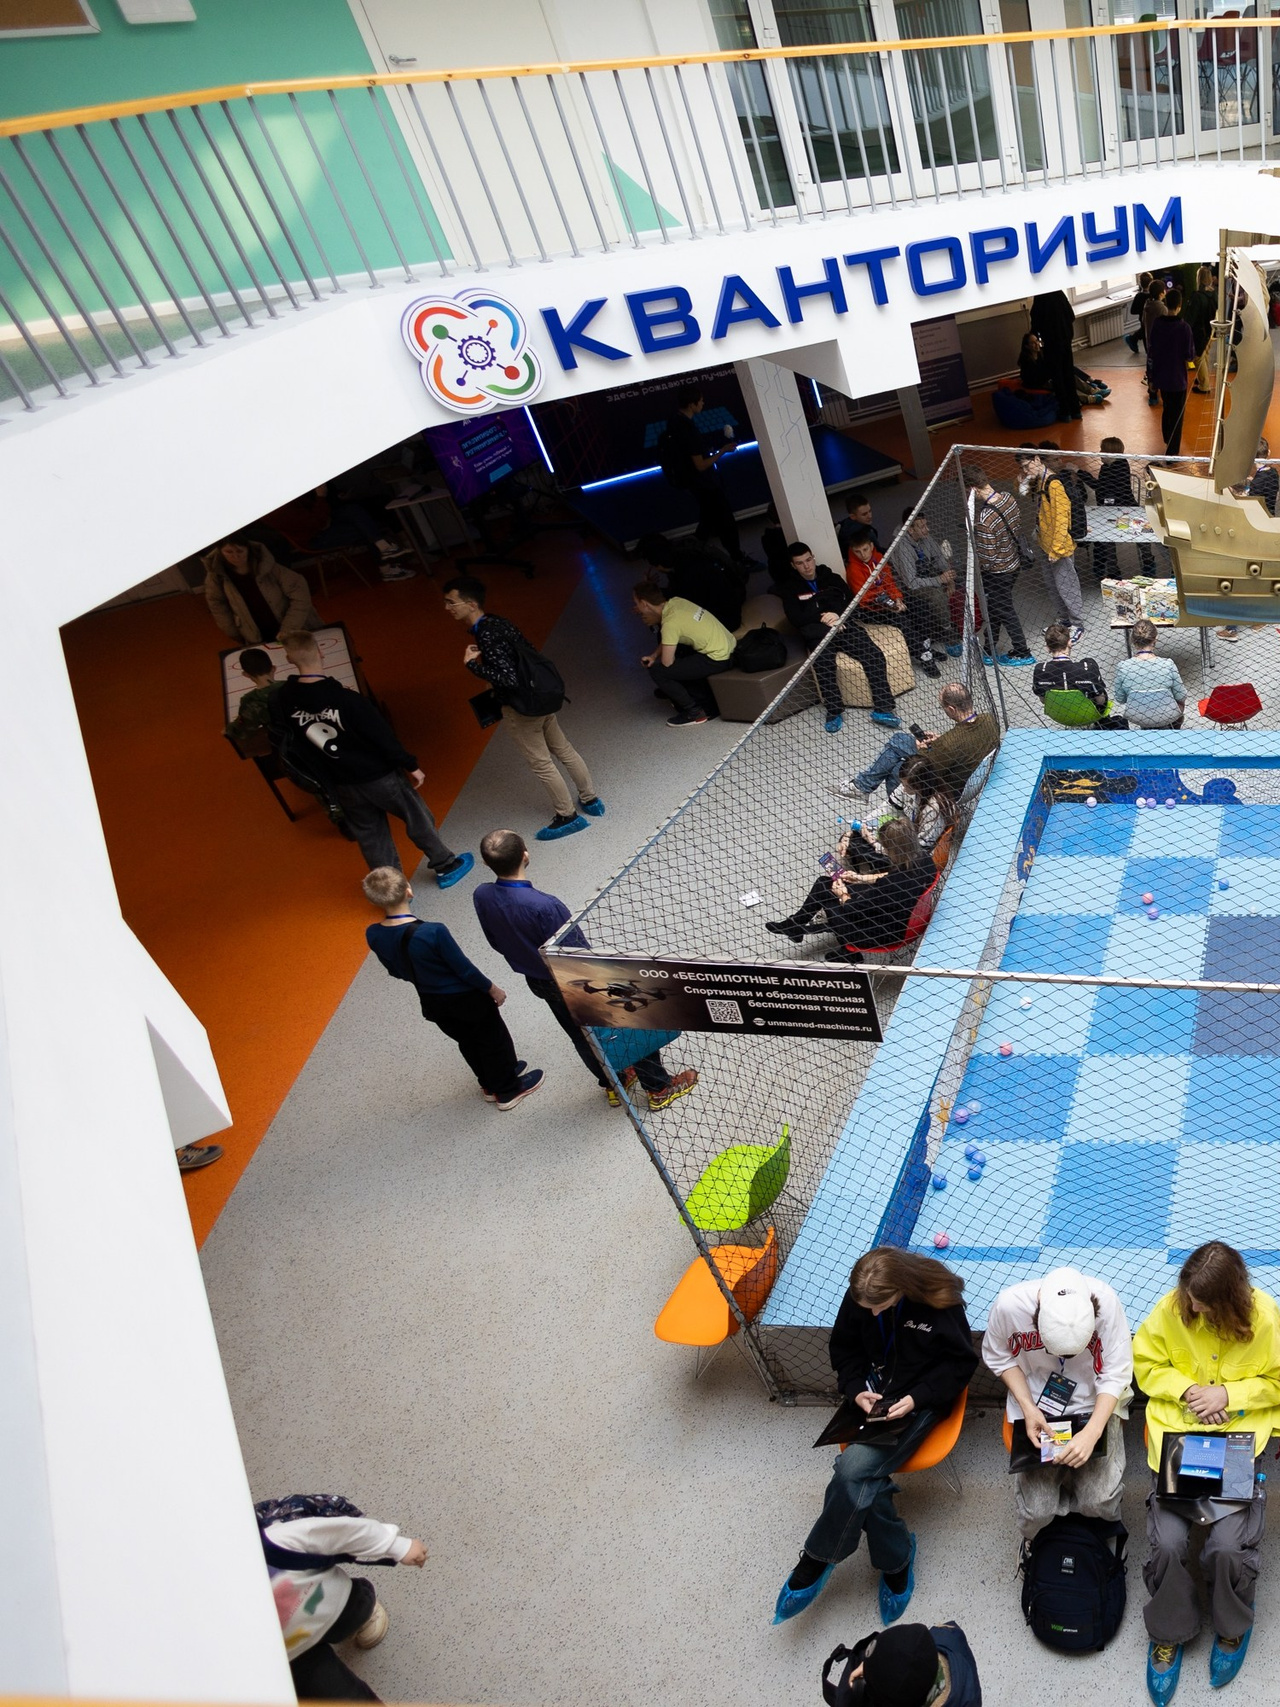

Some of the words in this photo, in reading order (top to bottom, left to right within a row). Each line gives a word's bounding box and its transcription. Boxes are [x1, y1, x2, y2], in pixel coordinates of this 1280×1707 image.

[539, 195, 1184, 371] КВАНТОРИУМ
[639, 969, 669, 979] ООО
[672, 971, 780, 985] «БЕСПИЛОТНЫЕ
[783, 977, 862, 990] АППАРАТЫ»
[684, 985, 753, 997] Спортивная
[766, 991, 865, 1004] образовательная
[748, 1000, 821, 1012] беспилотная
[823, 1005, 868, 1015] техника
[767, 1020, 873, 1032] unmanned-machines.ru
